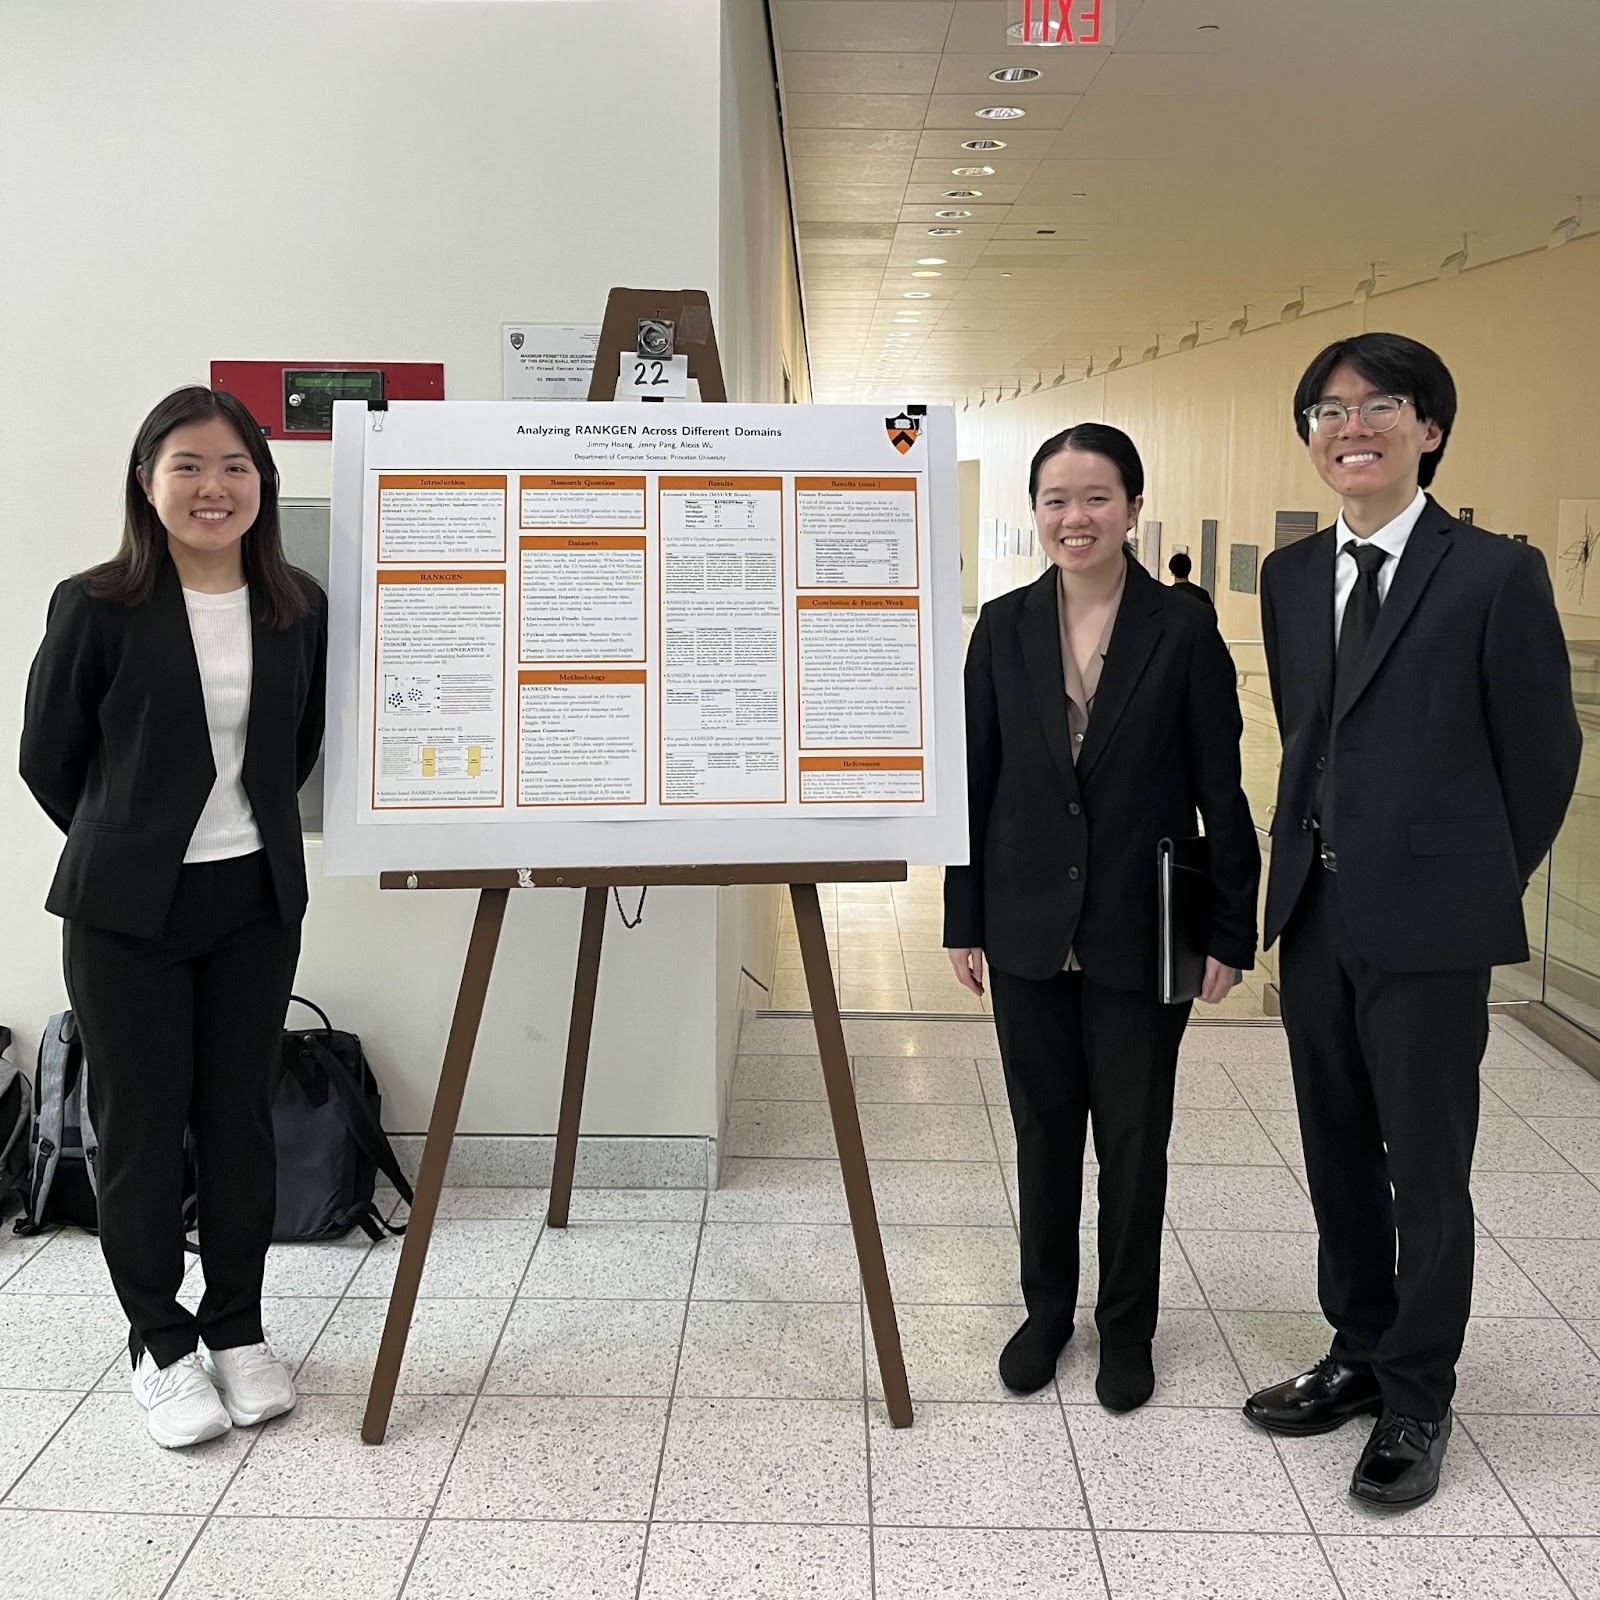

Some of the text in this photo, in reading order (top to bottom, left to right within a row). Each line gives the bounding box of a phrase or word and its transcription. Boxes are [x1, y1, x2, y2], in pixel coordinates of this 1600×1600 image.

[634, 361, 669, 385] 22
[517, 426, 782, 437] Analyzing RANKGEN Across Different Domains
[587, 441, 608, 449] Jimmy
[638, 441, 656, 450] Jenny
[659, 441, 677, 450] Pang,
